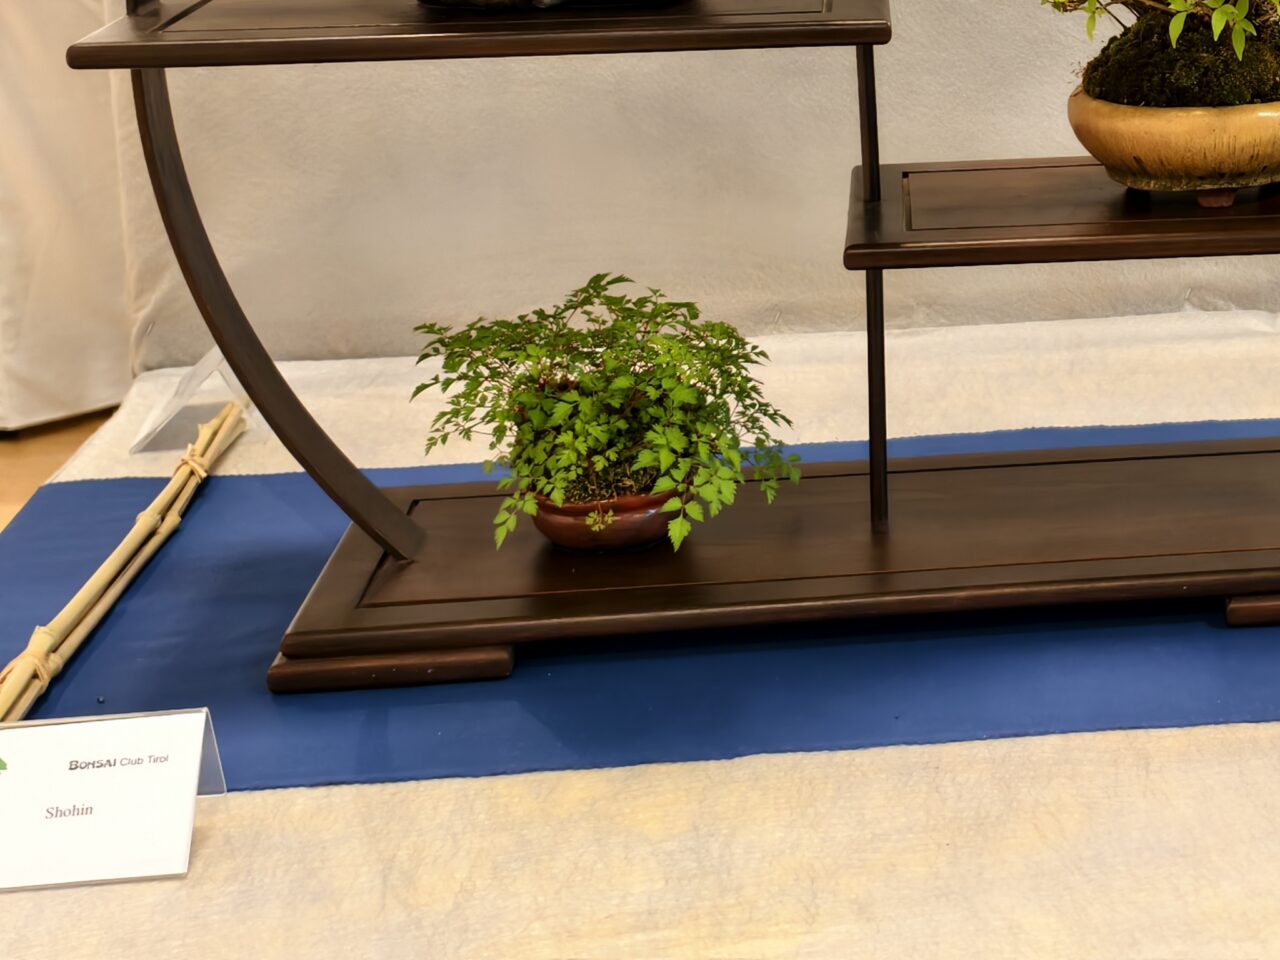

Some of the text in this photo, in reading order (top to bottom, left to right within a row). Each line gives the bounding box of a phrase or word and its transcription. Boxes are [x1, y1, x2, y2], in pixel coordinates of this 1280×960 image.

[68, 754, 169, 771] BONSAI Club Tirol
[45, 803, 93, 820] Shohin
